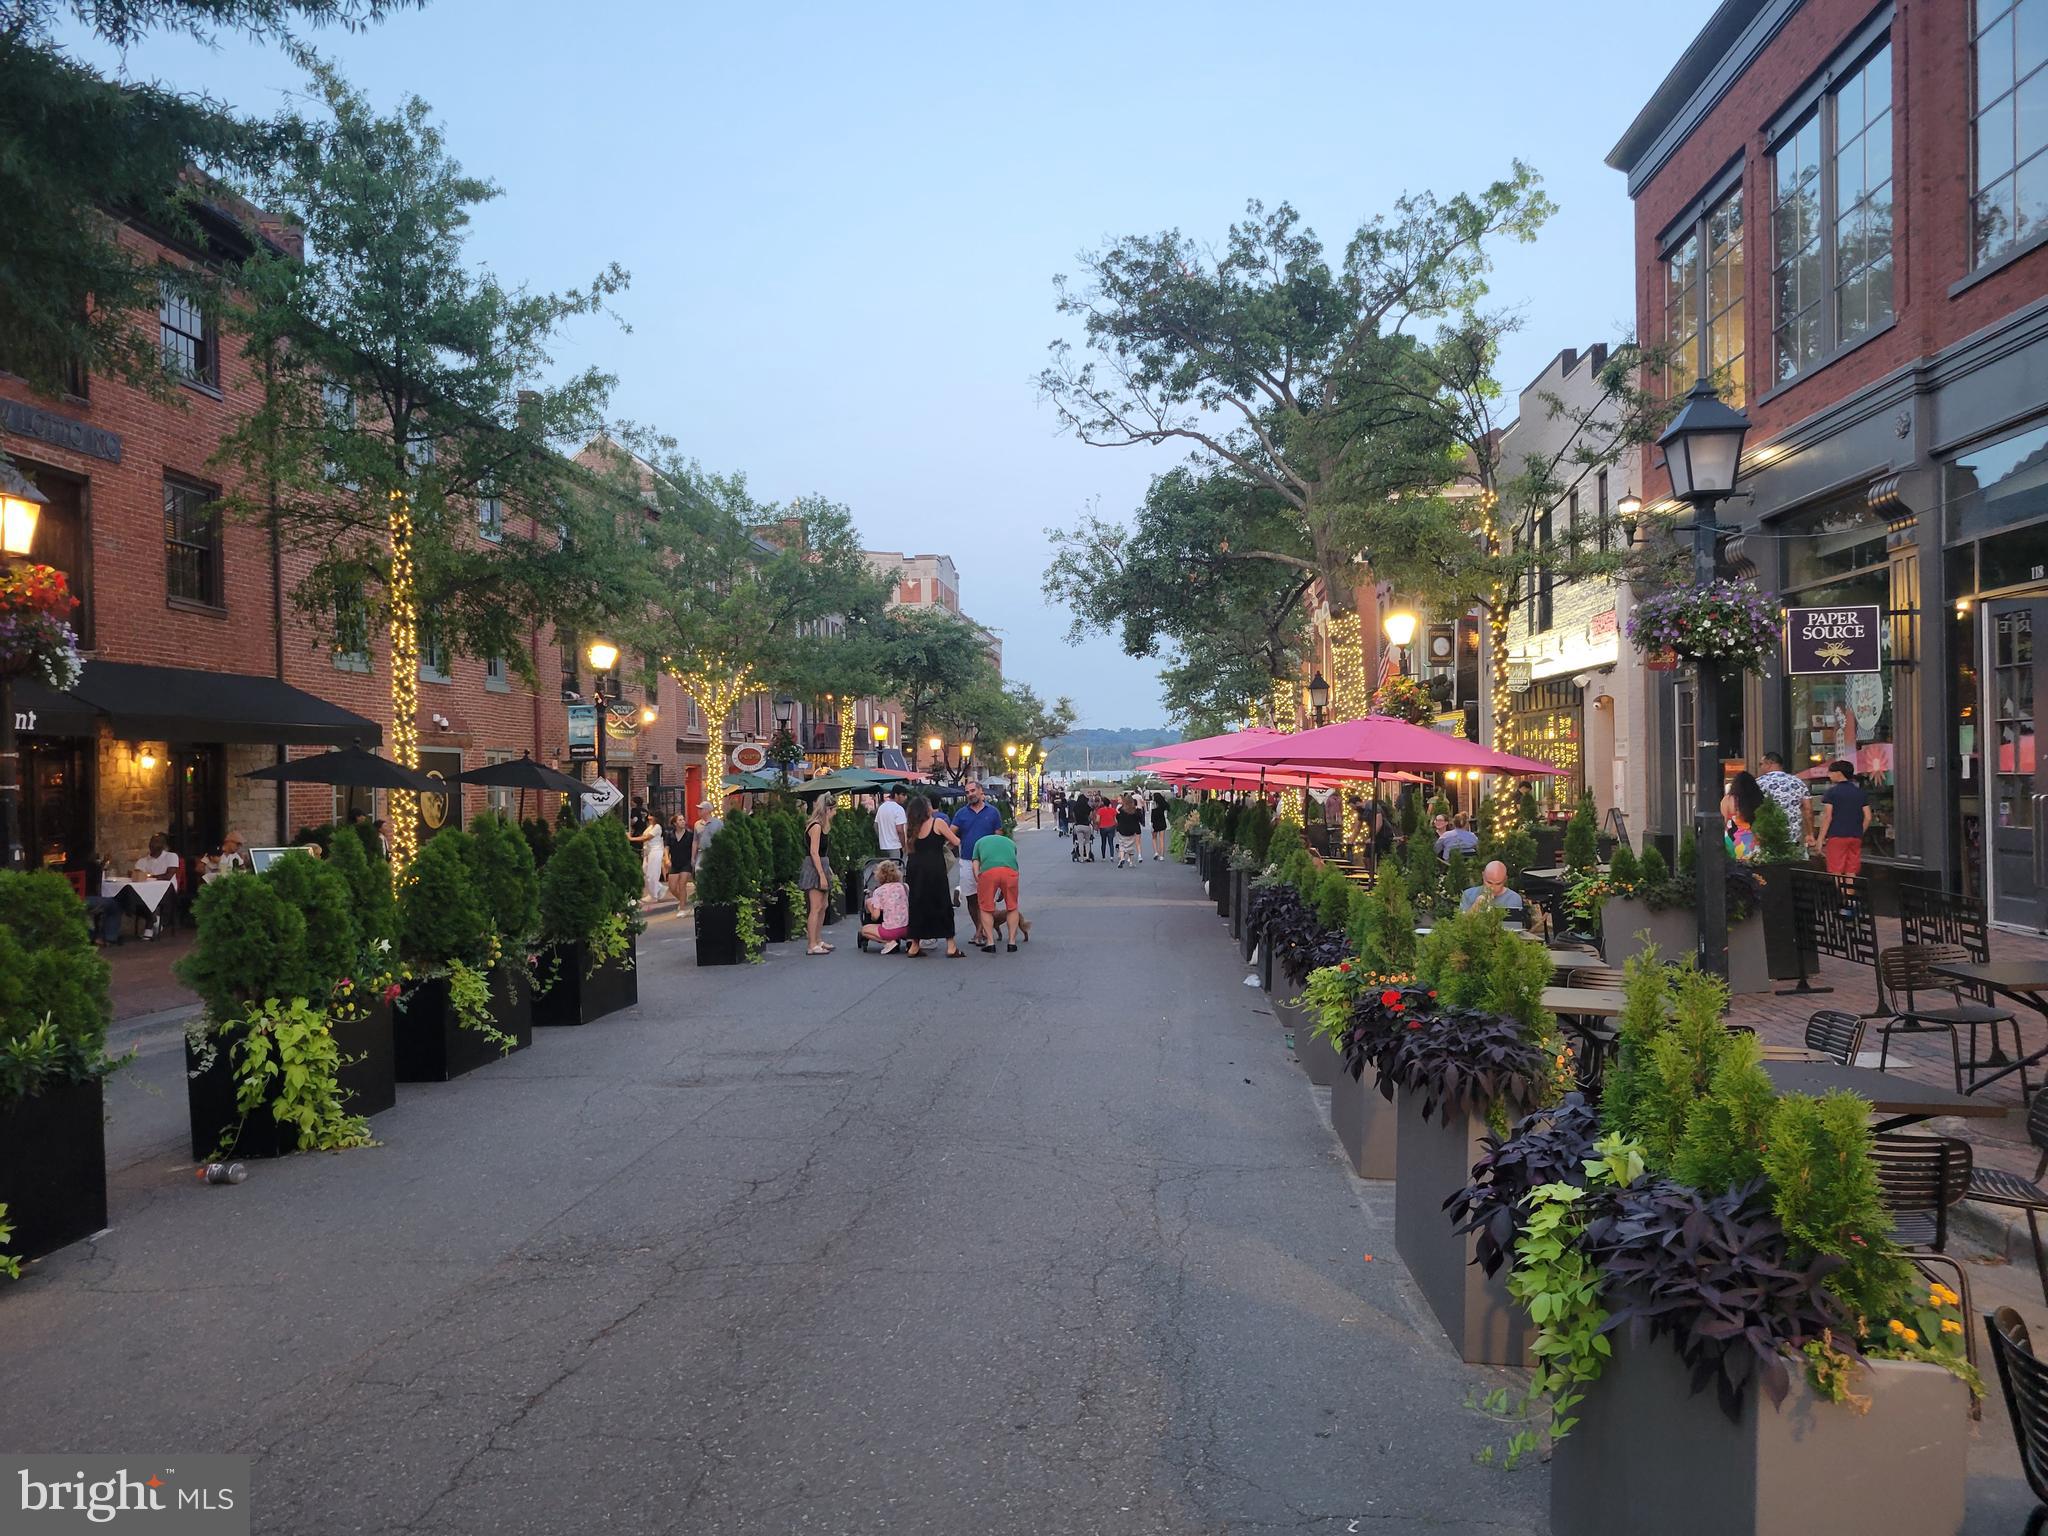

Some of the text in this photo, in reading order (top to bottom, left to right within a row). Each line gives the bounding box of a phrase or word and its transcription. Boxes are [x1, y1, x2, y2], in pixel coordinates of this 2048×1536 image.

[2031, 565, 2044, 580] 118
[1807, 612, 1860, 626] PAPER
[1802, 625, 1865, 640] SOURCE
[14, 710, 37, 730] nt
